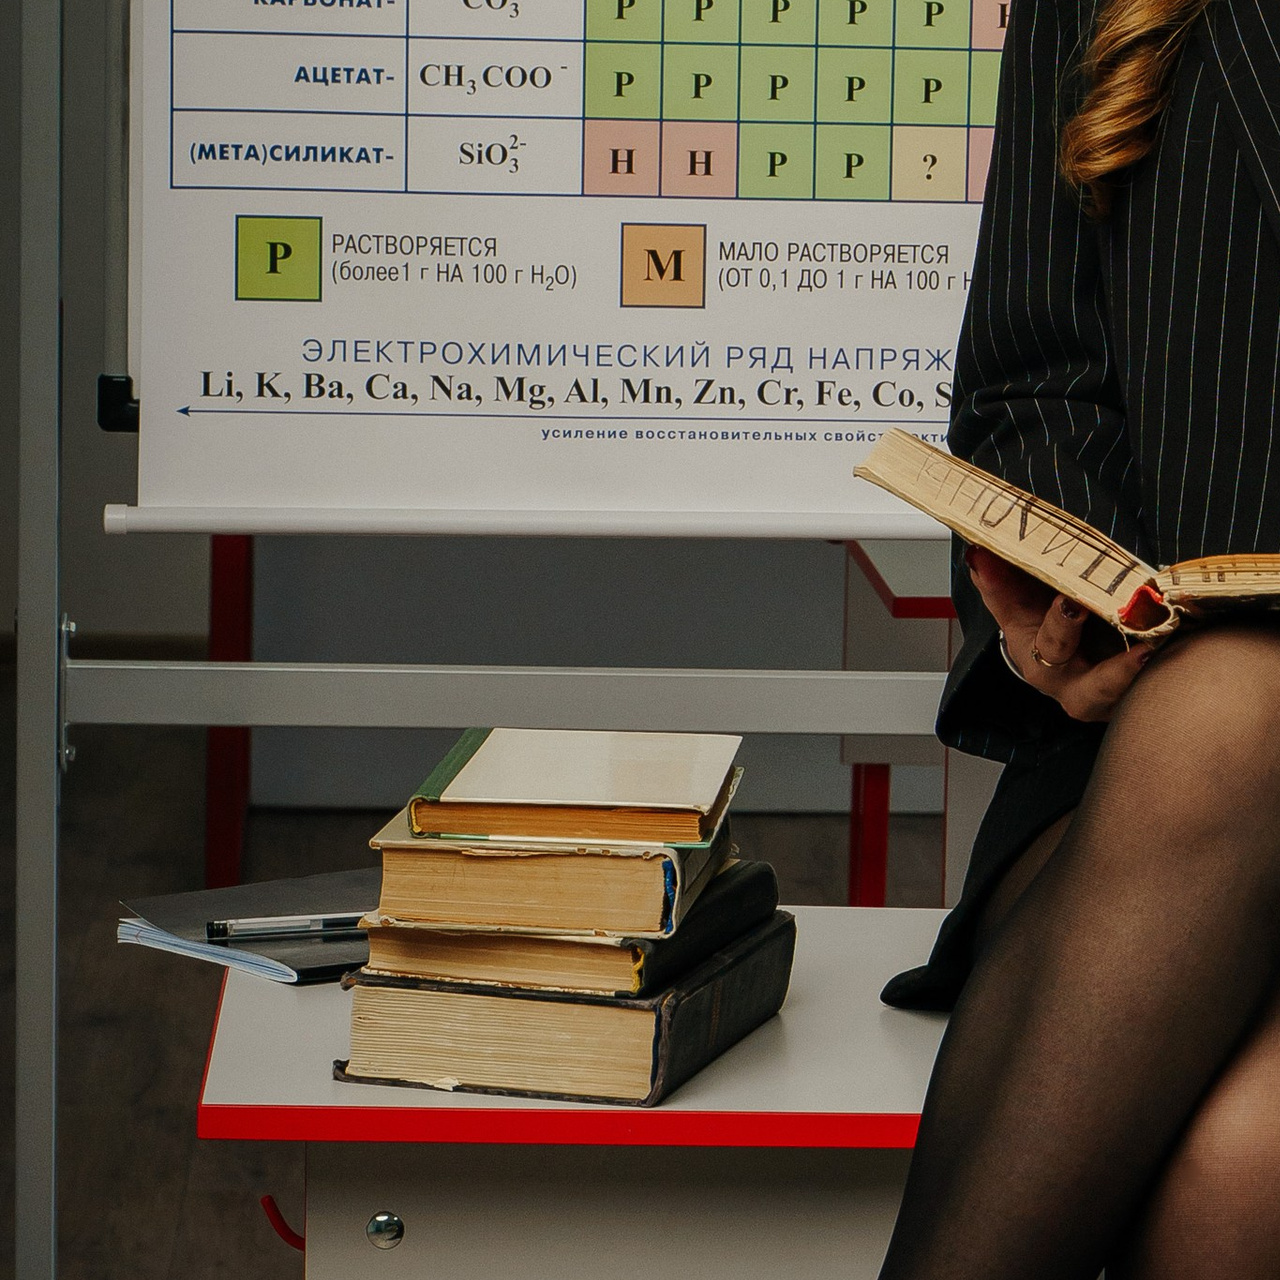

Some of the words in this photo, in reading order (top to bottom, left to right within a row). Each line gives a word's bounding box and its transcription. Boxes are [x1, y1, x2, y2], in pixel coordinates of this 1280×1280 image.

[293, 65, 395, 87] АЦЕТАТ-
[189, 142, 395, 167] (МЕТА)СИЛИКАТ-
[608, 148, 637, 175] Н
[686, 149, 715, 177] Н
[266, 239, 293, 274] Р
[332, 233, 497, 258] РАСТВОРЯЕТСЯ
[719, 241, 779, 262] МАЛО
[787, 242, 949, 265] РАСТВОРЯЕТСЯ
[420, 267, 430, 280] г
[436, 262, 464, 283] НА
[472, 263, 508, 285] 100
[514, 269, 524, 285] г
[642, 248, 686, 284] М
[718, 267, 754, 292] (ОТ
[759, 267, 788, 292] 0,1
[796, 268, 828, 293] ДО
[837, 269, 844, 289] 1
[854, 274, 864, 290] г
[870, 269, 898, 290] НА
[905, 269, 940, 291] 100
[947, 275, 957, 291] г
[301, 338, 710, 368] ЭЛЕКТРОХИМИЧЕСКИЙ
[726, 345, 794, 375] РЯД
[199, 370, 244, 404] Li,
[254, 371, 292, 405] K,
[302, 372, 354, 406] Ba,
[365, 373, 419, 407] Ca,
[428, 374, 483, 408] Na,
[493, 375, 555, 411] Mg,
[563, 377, 609, 410] Al,
[618, 377, 683, 411] Mn,
[692, 378, 746, 411] Zn,
[756, 378, 804, 412] Cr,
[814, 379, 861, 413] Fe,
[872, 380, 924, 414] Co,
[541, 428, 629, 441] усиление
[635, 429, 817, 442] восстановительных
